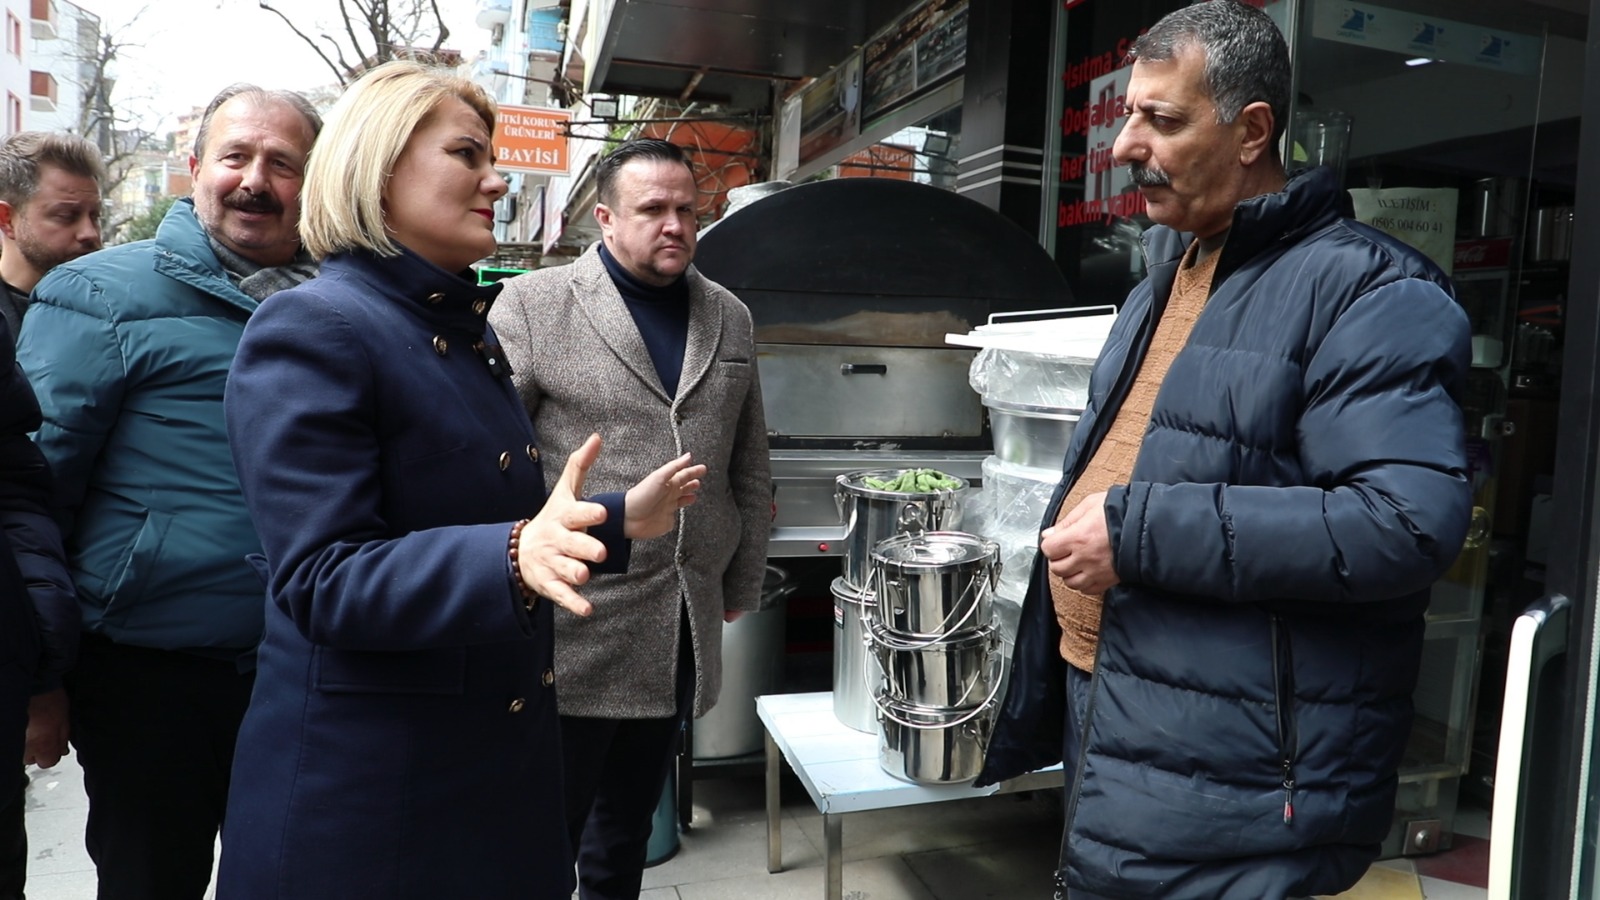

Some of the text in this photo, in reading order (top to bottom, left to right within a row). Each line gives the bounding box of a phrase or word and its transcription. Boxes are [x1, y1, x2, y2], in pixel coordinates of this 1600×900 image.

[1063, 95, 1125, 136] Doğalga
[504, 125, 555, 140] ÜRÜNLERİ
[499, 147, 558, 165] BAYİSİ
[1061, 153, 1087, 182] her
[1059, 198, 1102, 228] bakım
[1415, 221, 1430, 233] 60
[1432, 222, 1443, 233] 41
